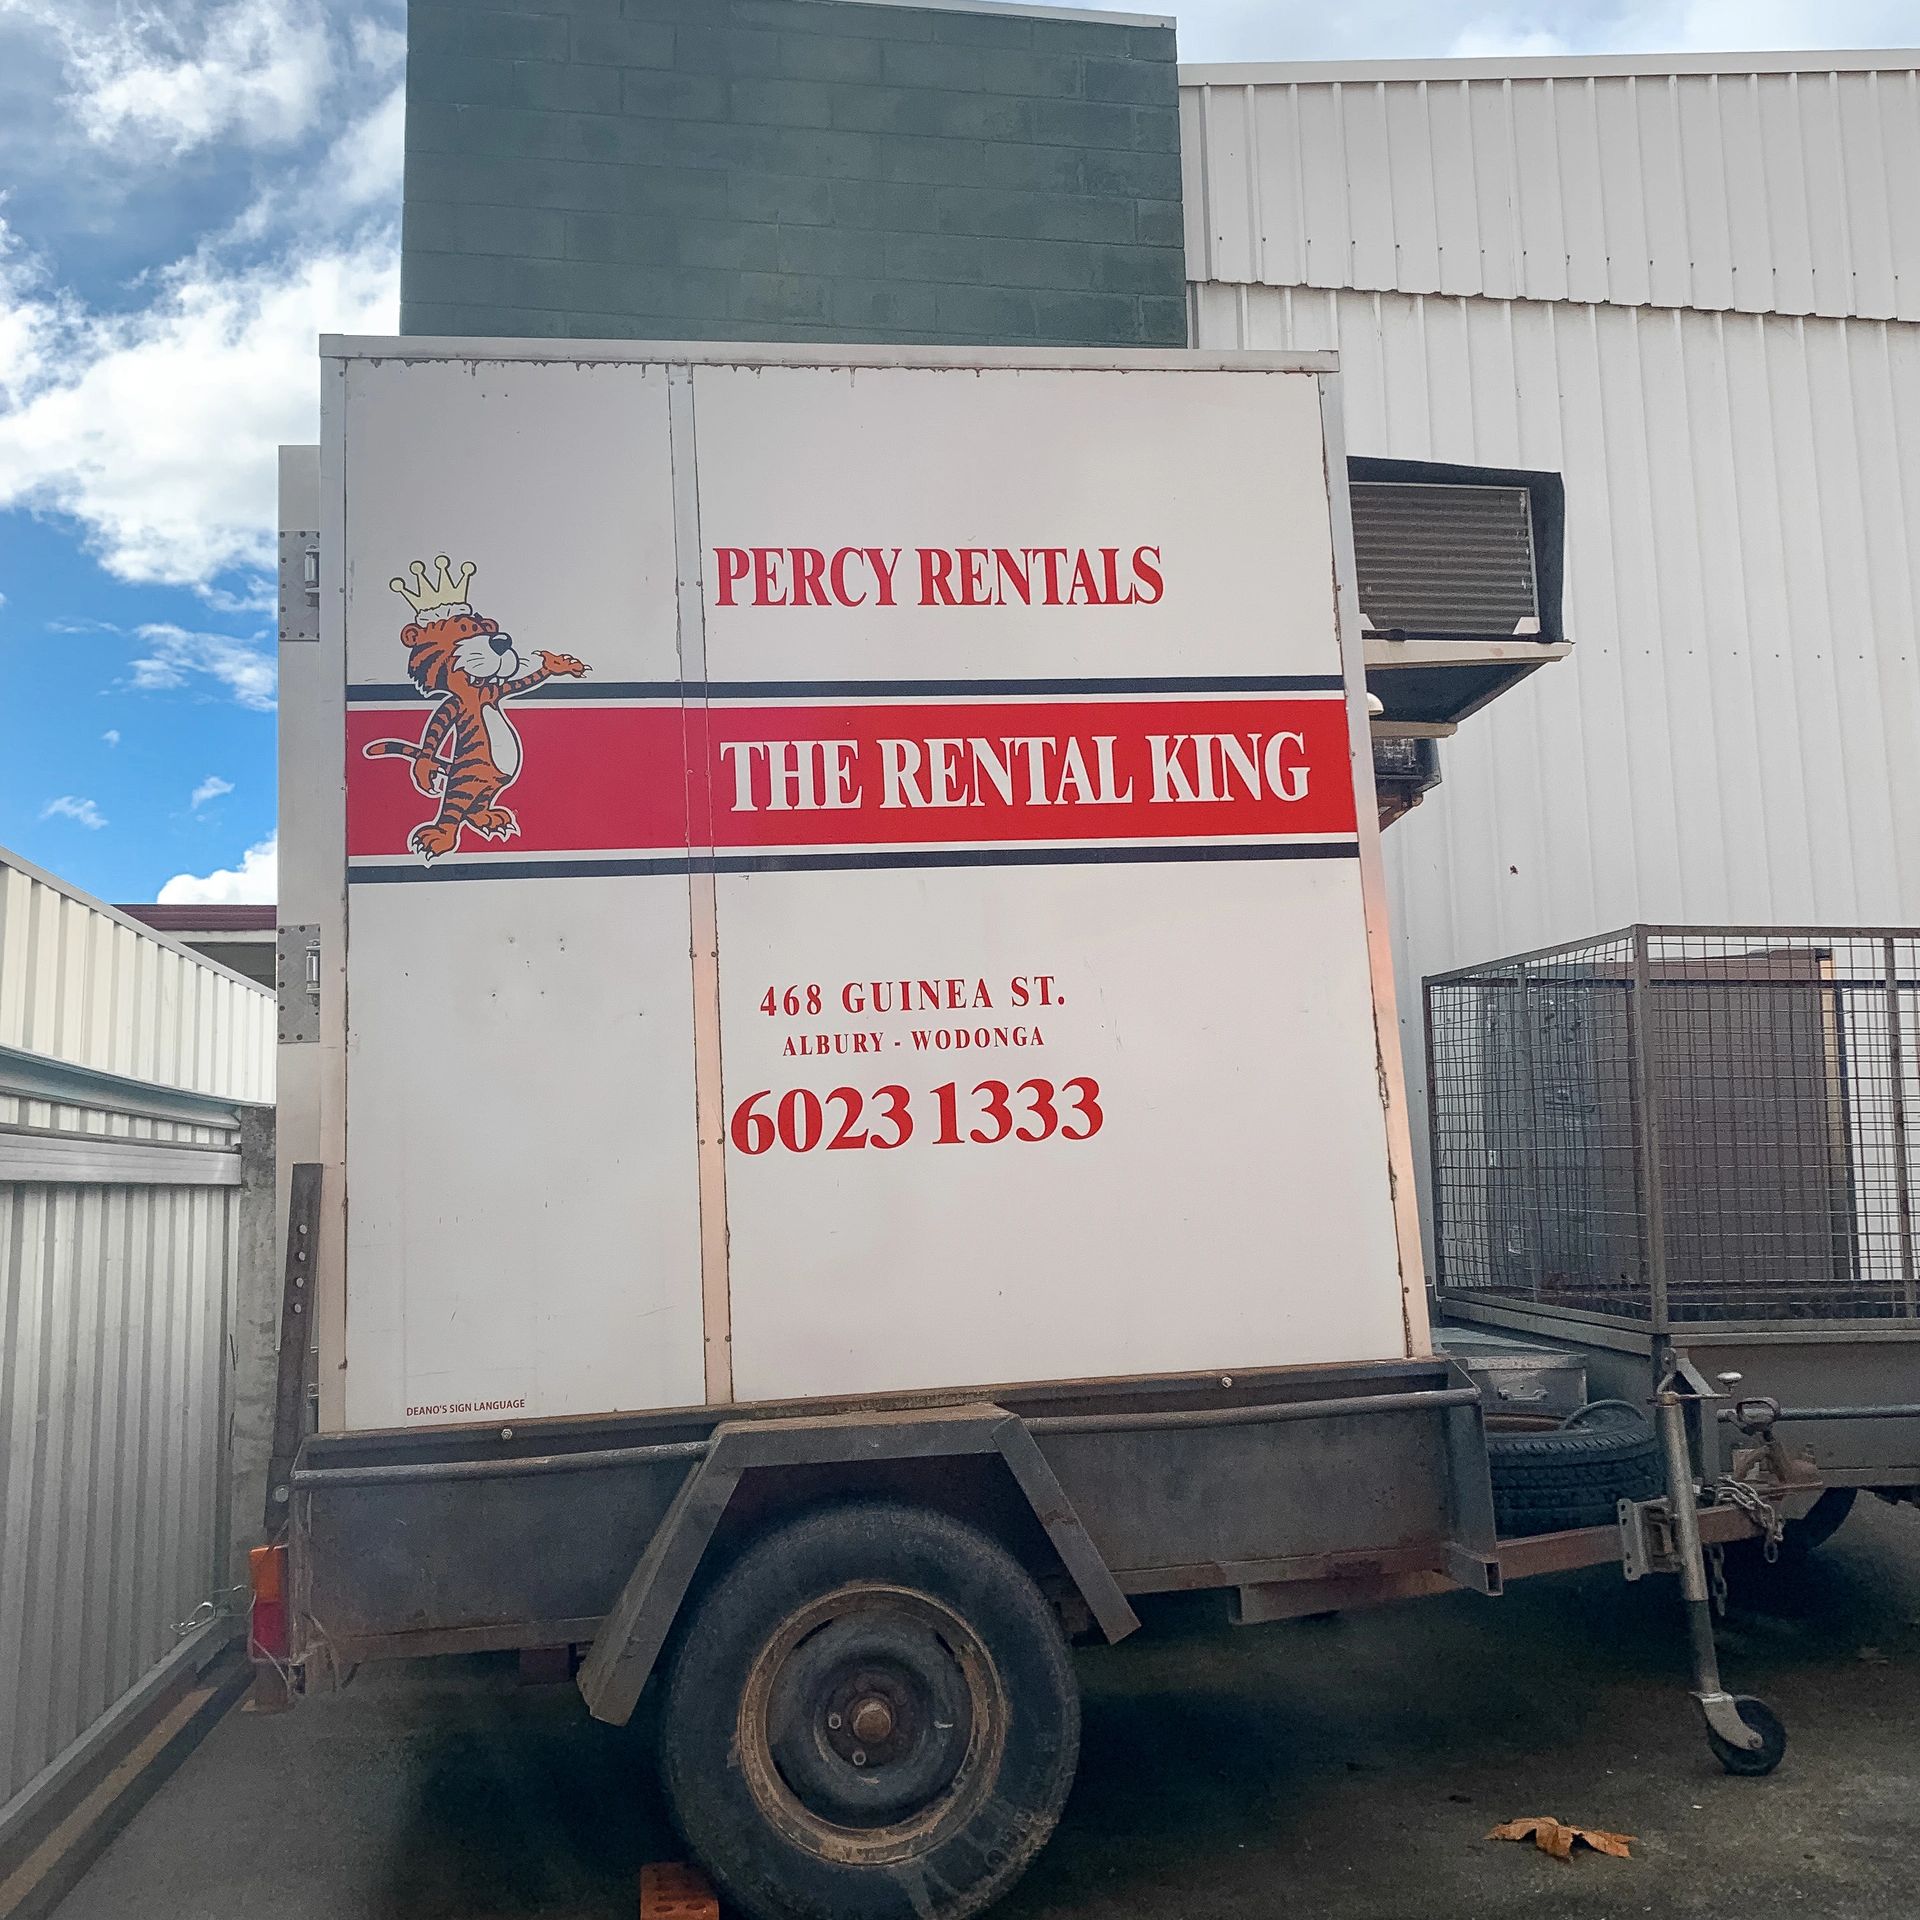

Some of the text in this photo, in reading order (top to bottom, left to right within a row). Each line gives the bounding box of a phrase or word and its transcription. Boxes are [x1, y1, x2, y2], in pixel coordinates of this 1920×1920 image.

[714, 545, 1163, 608] PERCY RENTALS
[720, 732, 1311, 811] THE RENTAL KING
[759, 975, 1065, 1017] 468 GUINEA ST.
[783, 1031, 883, 1057] ALBURY
[911, 1027, 1044, 1051] WODONGA
[730, 1076, 1104, 1155] 6023 1333
[406, 1399, 525, 1416] DEANO'S SIGN LANGUAGE
